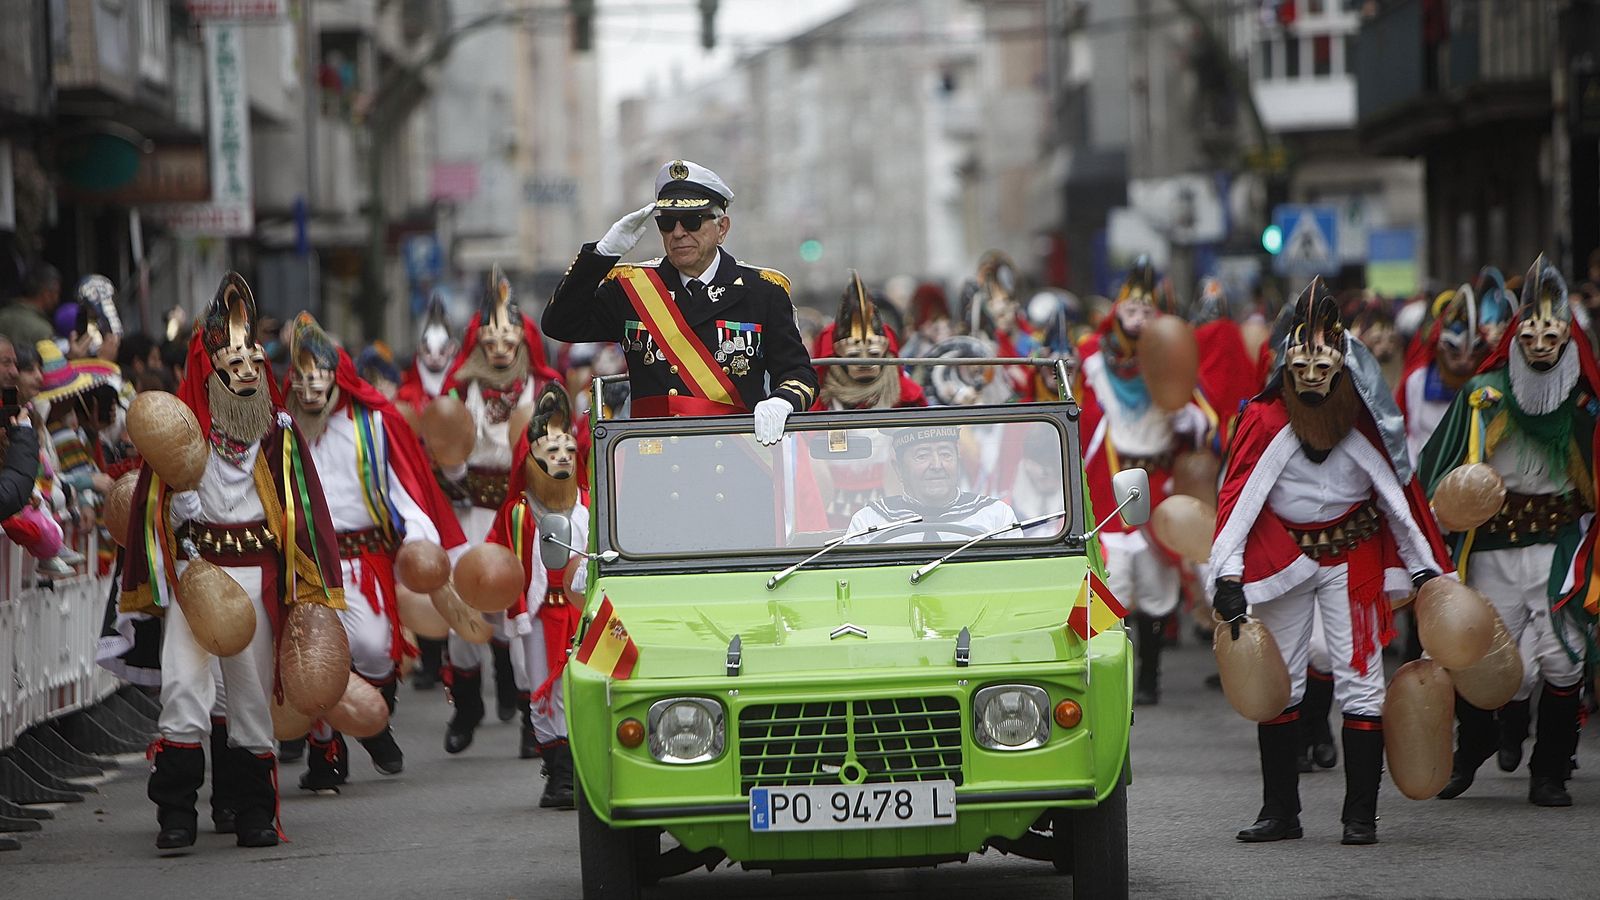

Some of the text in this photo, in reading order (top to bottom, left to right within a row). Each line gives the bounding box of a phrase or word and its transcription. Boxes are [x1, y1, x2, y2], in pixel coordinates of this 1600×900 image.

[771, 787, 952, 825] PO 9478 L
[757, 813, 765, 824] E
